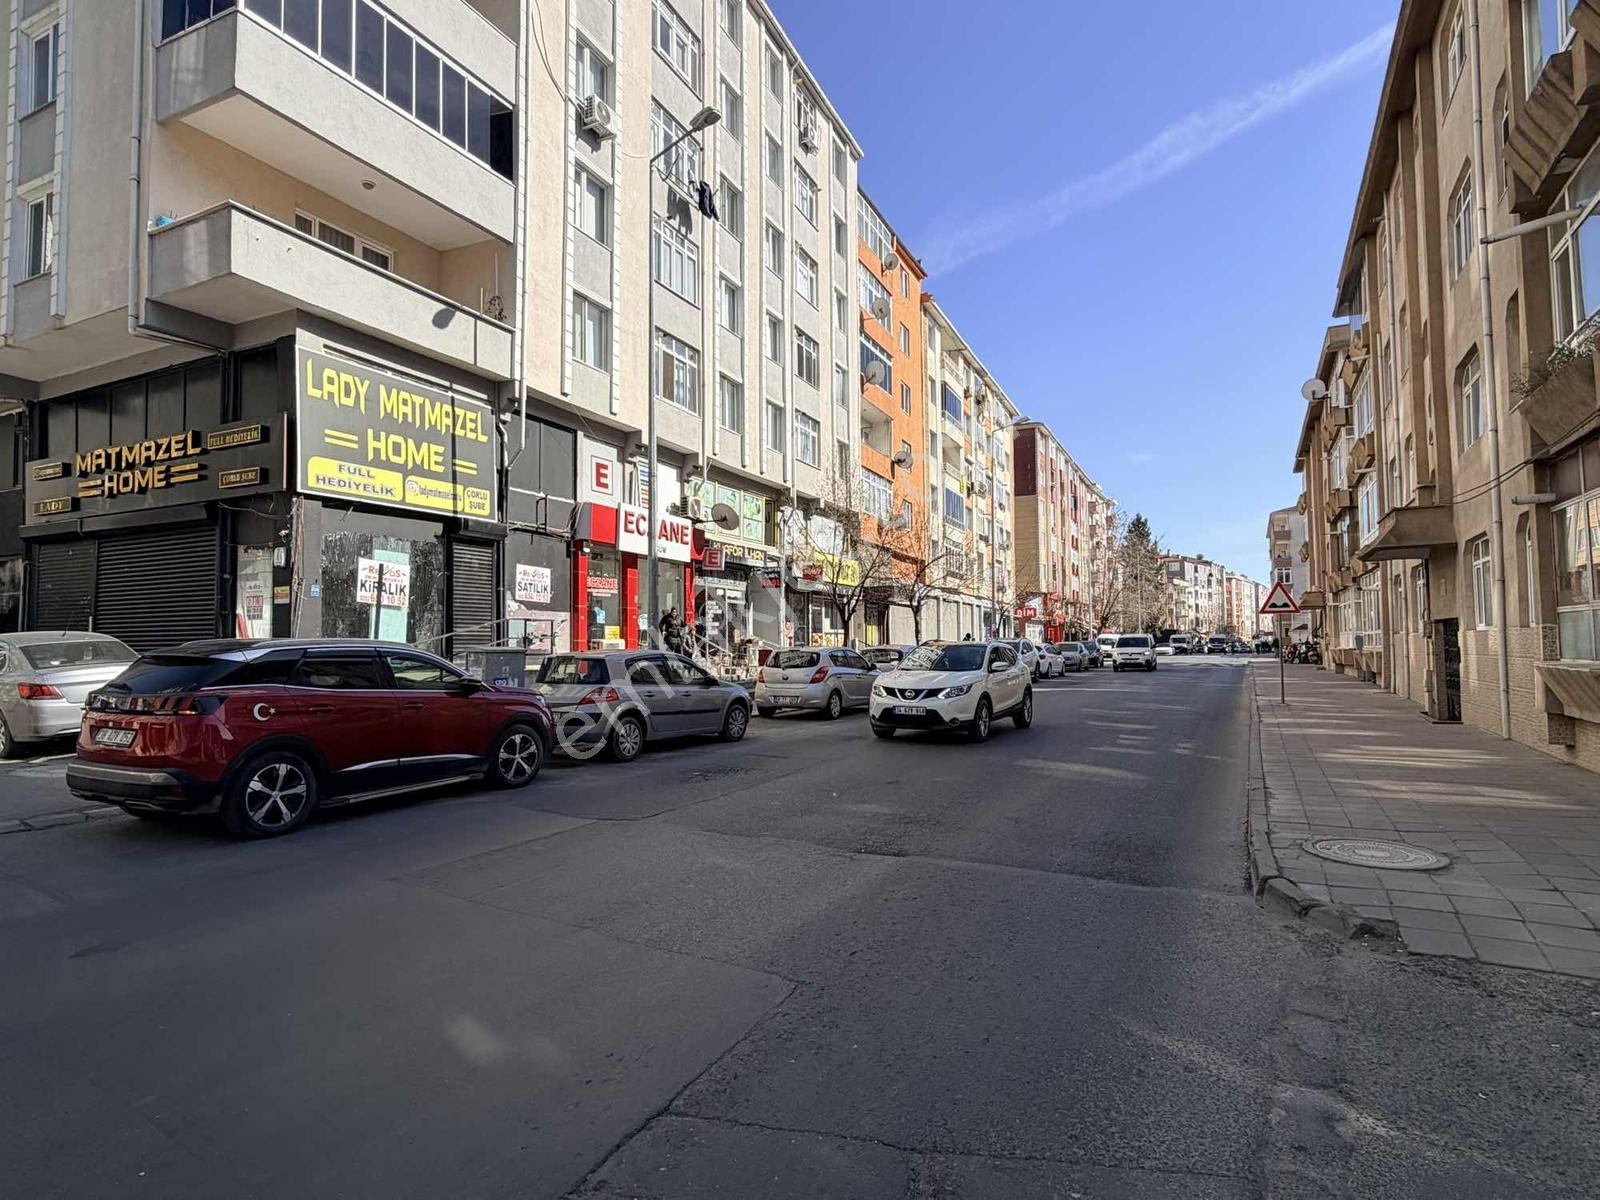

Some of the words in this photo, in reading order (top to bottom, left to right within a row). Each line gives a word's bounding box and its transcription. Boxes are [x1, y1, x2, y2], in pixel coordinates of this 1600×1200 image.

[306, 358, 370, 415] LADY
[379, 384, 488, 443] MATMAZEL
[76, 430, 201, 477] MATMAZEL
[367, 428, 445, 473] HOME
[104, 465, 167, 498] HOME
[339, 464, 375, 479] FULL
[595, 462, 608, 489] E
[40, 501, 64, 512] LADY
[623, 510, 690, 545] ECANE
[708, 551, 719, 565] E
[518, 581, 549, 594] SATILIK
